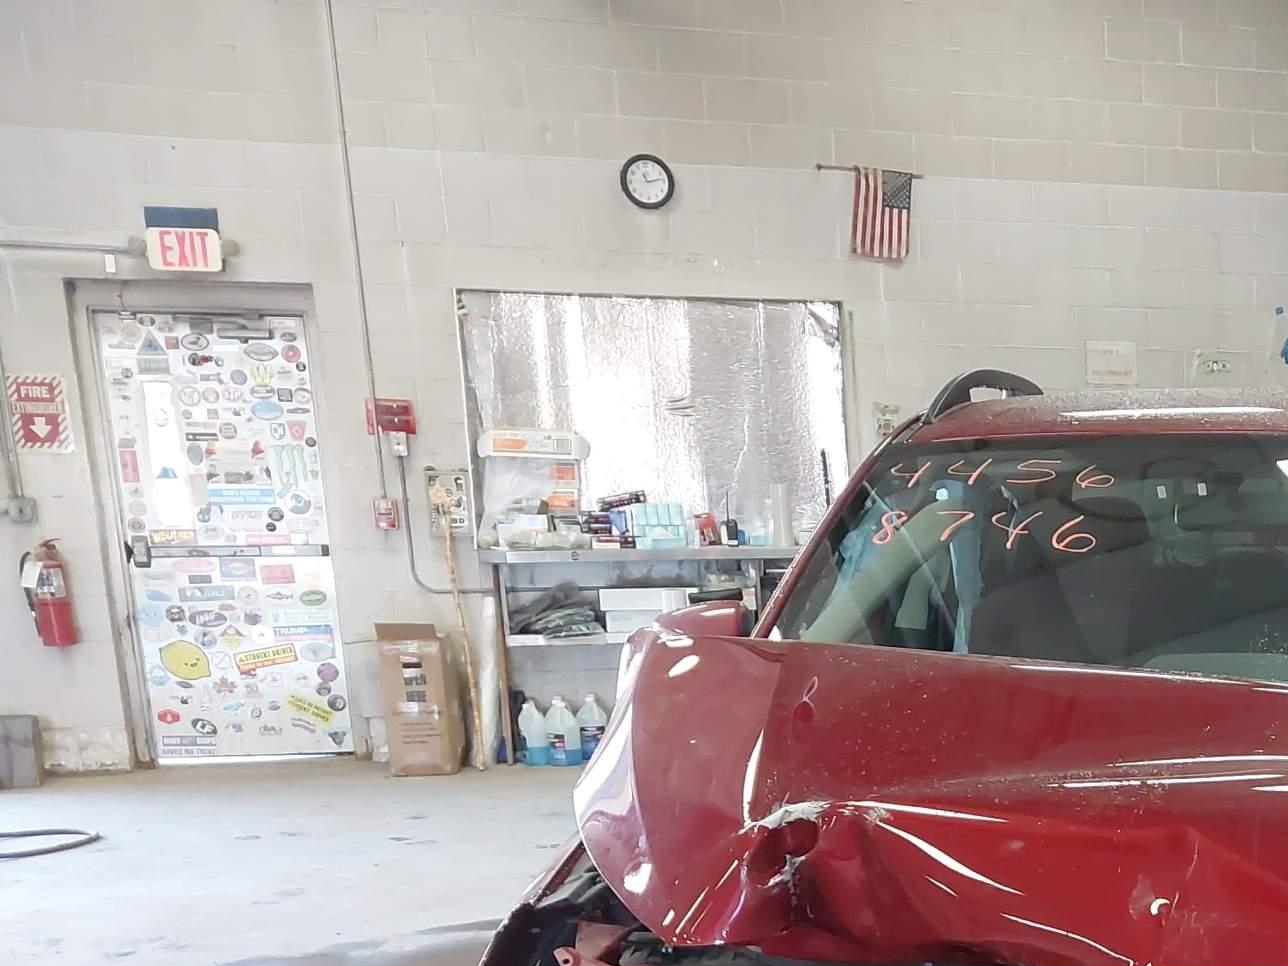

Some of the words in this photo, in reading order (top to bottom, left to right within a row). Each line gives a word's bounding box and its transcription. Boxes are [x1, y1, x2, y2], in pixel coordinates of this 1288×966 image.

[159, 230, 208, 267] EXIT
[20, 385, 50, 399] FIRE
[890, 458, 1115, 489] 4456
[872, 510, 1097, 553] 8746
[244, 651, 271, 662] STUDENT
[271, 646, 293, 657] DRIVER
